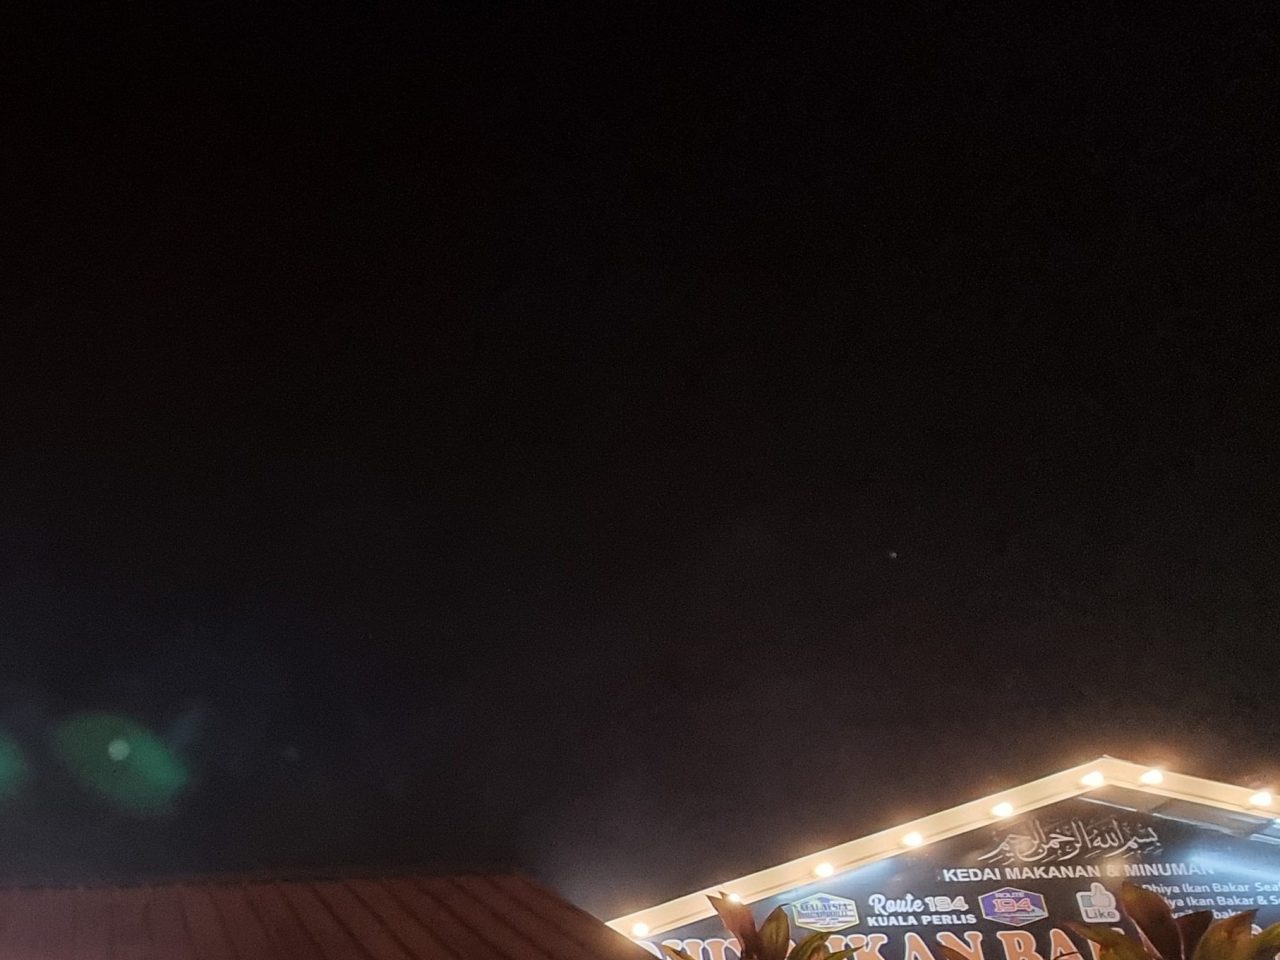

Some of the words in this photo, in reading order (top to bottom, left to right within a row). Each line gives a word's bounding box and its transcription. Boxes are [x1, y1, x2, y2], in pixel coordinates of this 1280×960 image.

[943, 868, 1001, 882] KEDAI
[1006, 865, 1100, 880] MAKANAN
[1106, 864, 1120, 877] &
[1125, 861, 1215, 877] MINUMAN
[1182, 882, 1210, 893] Ikan
[1212, 882, 1250, 892] Bakar
[869, 894, 924, 916] Route
[925, 896, 969, 912] 194
[993, 898, 1033, 913] 194
[1186, 896, 1214, 907] Ikan
[1218, 896, 1254, 906] Bakar
[867, 915, 918, 927] KUALA
[920, 913, 977, 927] PERLIS
[1086, 909, 1116, 920] Like
